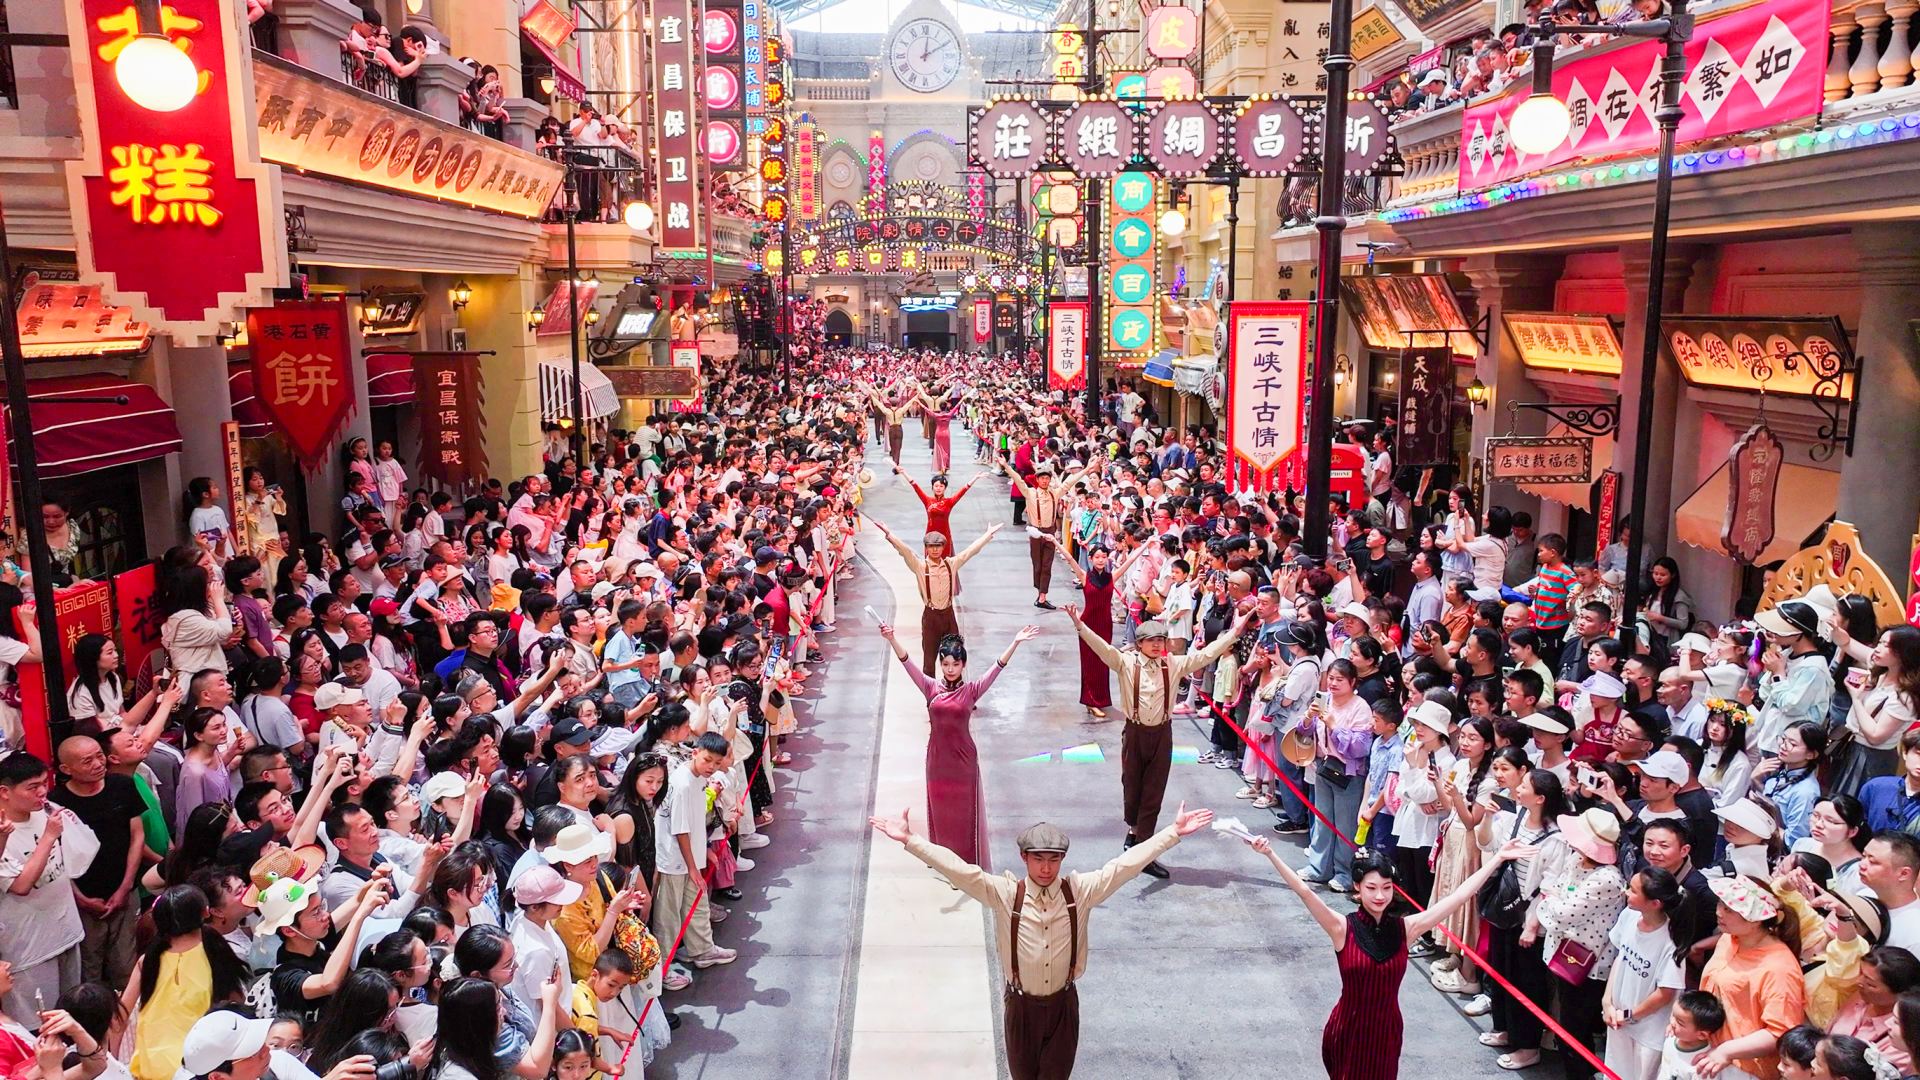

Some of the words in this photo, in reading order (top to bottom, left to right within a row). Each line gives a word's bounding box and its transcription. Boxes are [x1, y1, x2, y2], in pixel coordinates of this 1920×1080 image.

[659, 15, 690, 230] 宜昌保卫战
[993, 113, 1375, 160] 新昌綢緞莊
[856, 221, 977, 242] 千古情劇院
[1060, 313, 1075, 370] 三峡千古情
[265, 350, 339, 407] 餅
[1251, 327, 1285, 449] 三峡千古情
[437, 369, 462, 466] 宜昌保衛戰
[1499, 453, 1579, 470] 德福裁縫店
